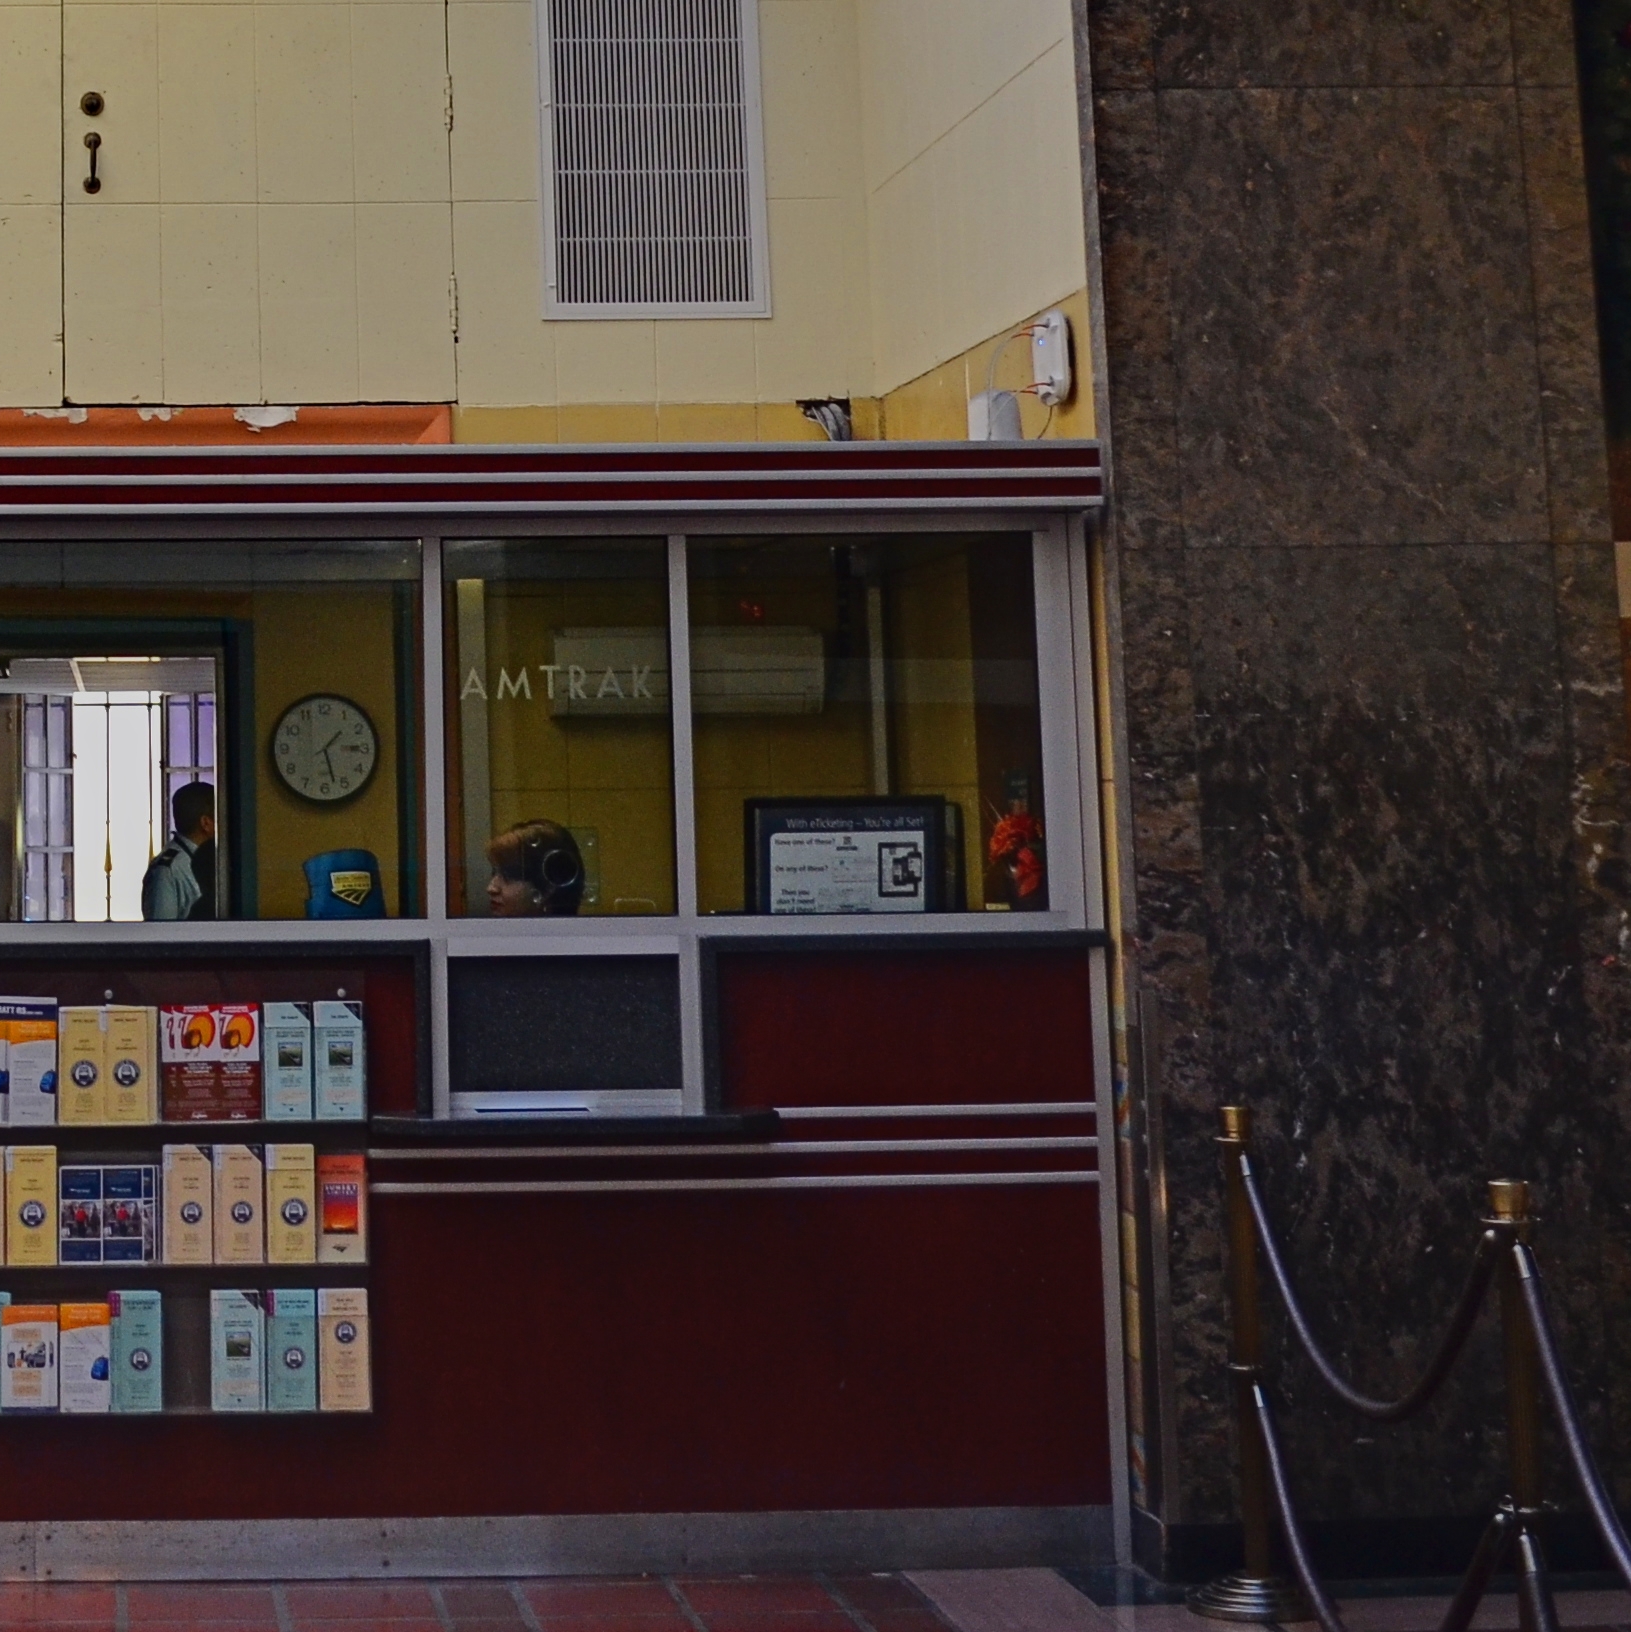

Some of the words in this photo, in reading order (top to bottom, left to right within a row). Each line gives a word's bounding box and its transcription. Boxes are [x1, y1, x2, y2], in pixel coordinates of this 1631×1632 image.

[459, 664, 654, 700] AMTRAK
[300, 709, 311, 720] 11
[317, 704, 331, 715] 12
[286, 725, 299, 736] 10
[354, 724, 364, 735] 2
[280, 744, 289, 754] 9
[360, 743, 369, 754] 3
[286, 763, 296, 775] 8
[354, 763, 363, 774] 4
[340, 777, 349, 788] 5
[320, 783, 330, 794] 6
[786, 818, 808, 829] With
[810, 817, 854, 830] eTicketing
[893, 817, 904, 827] all
